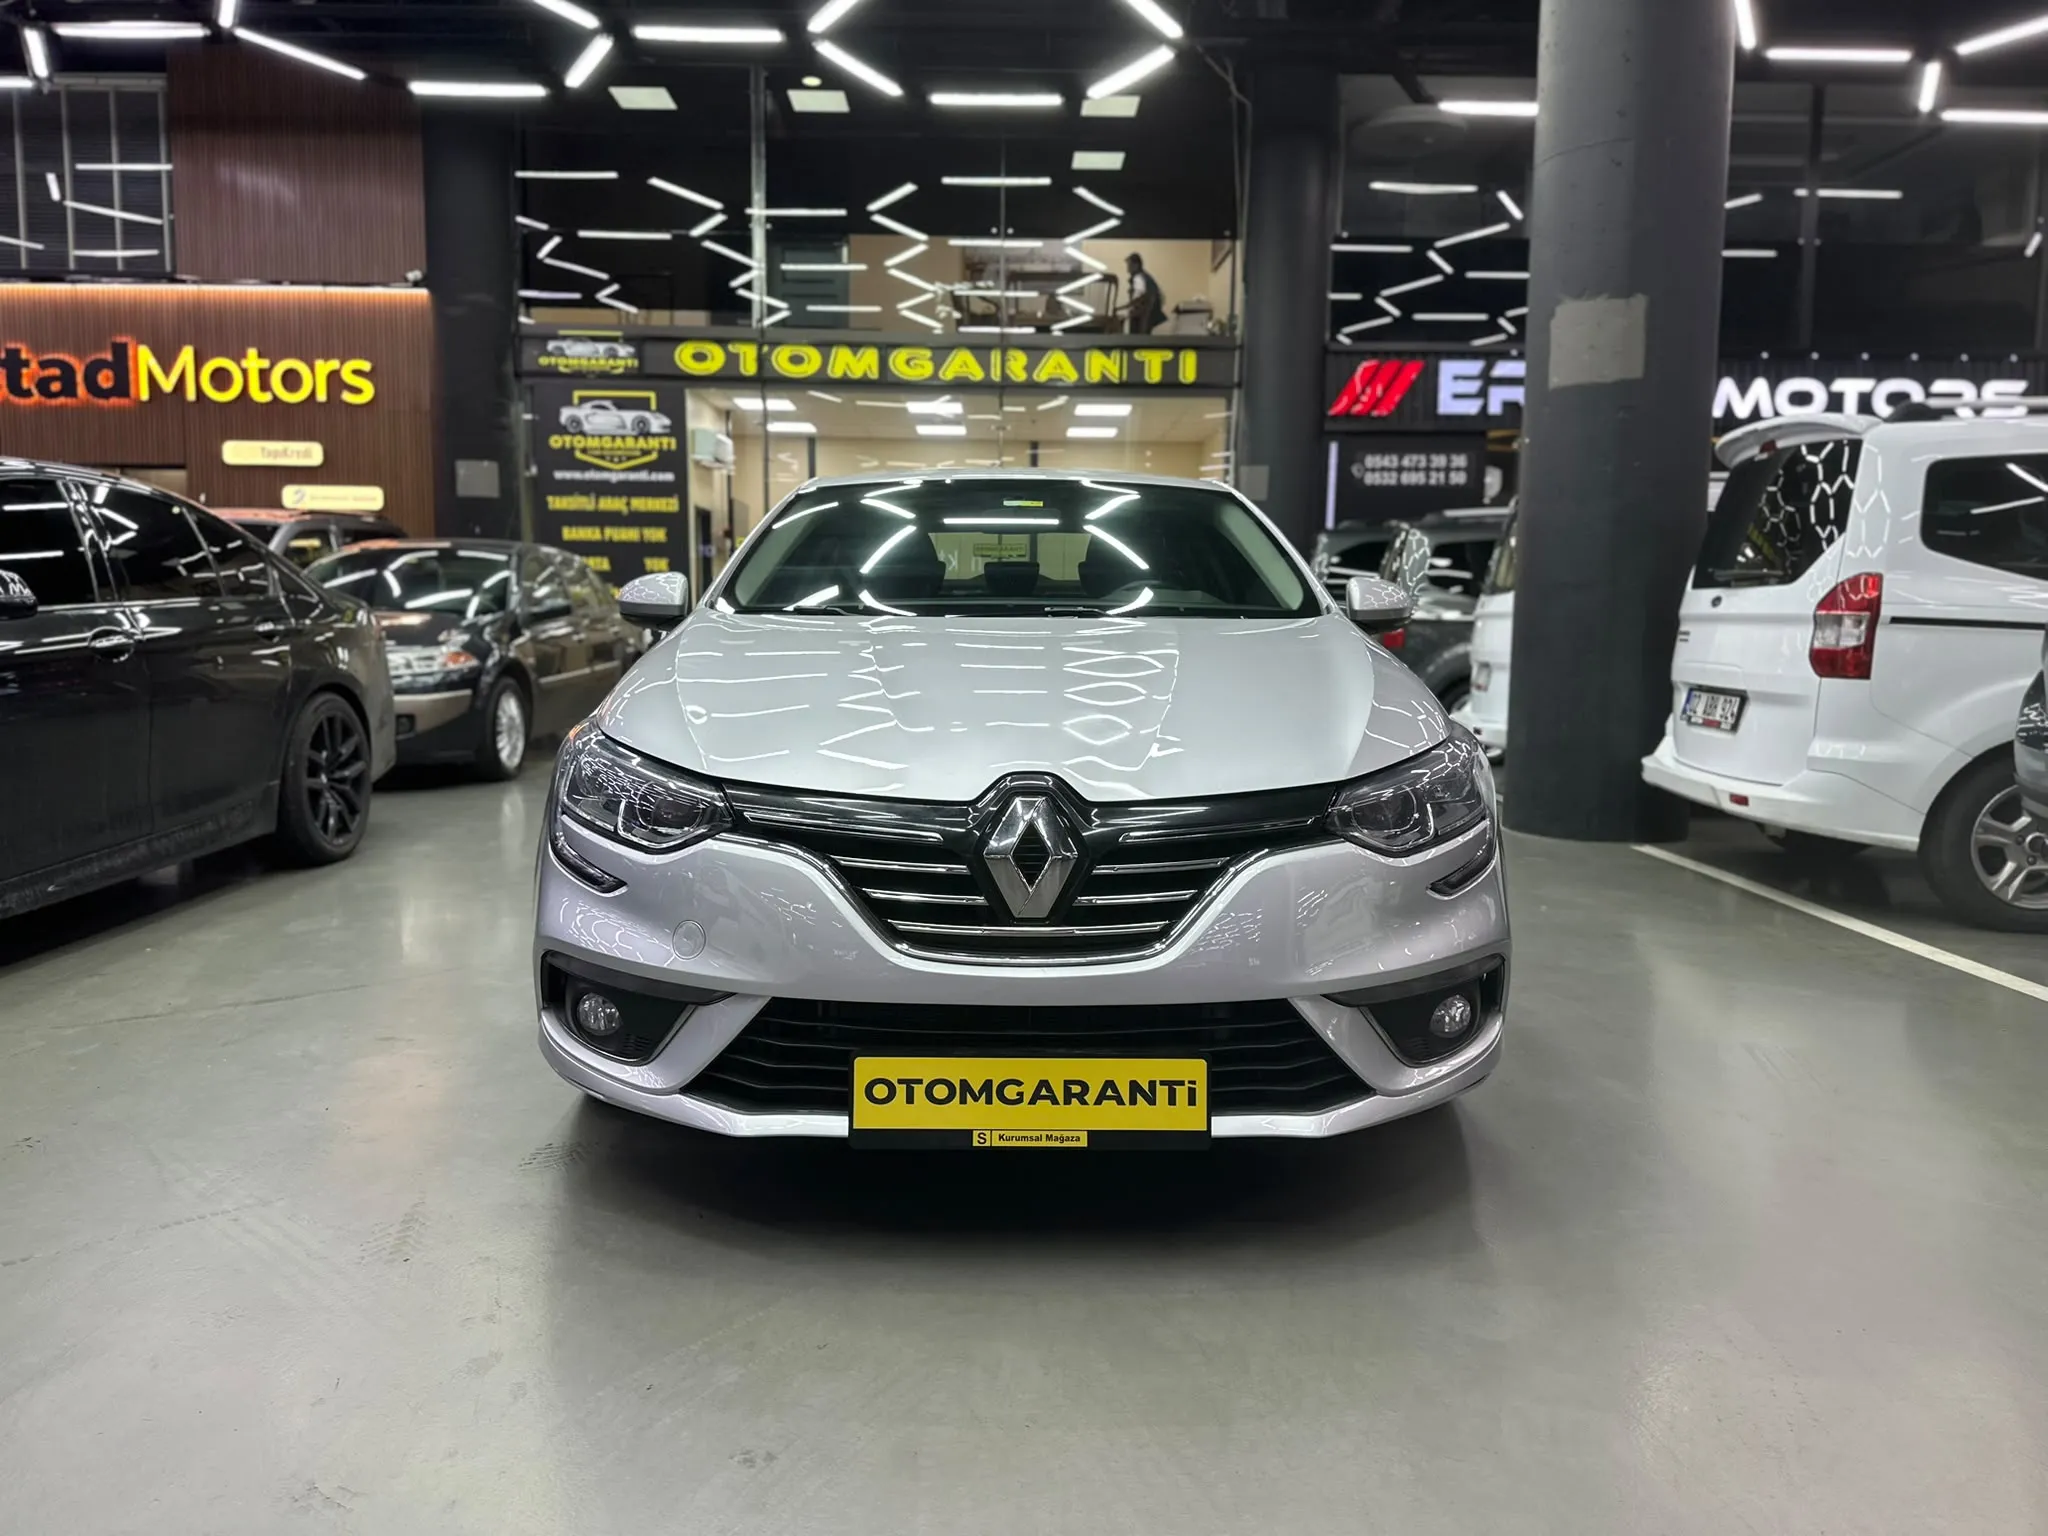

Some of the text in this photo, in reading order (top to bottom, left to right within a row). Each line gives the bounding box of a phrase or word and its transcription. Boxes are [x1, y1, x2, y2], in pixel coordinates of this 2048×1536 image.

[673, 340, 1197, 385] OTOMGARANTI
[1711, 376, 2030, 419] MOTORS
[548, 435, 677, 451] OTOMGARANTI
[1364, 453, 1398, 469] 0543
[1363, 470, 1398, 486] 0532
[977, 1132, 987, 1145] S
[998, 1133, 1081, 1144] Kurumsal Mağaza
